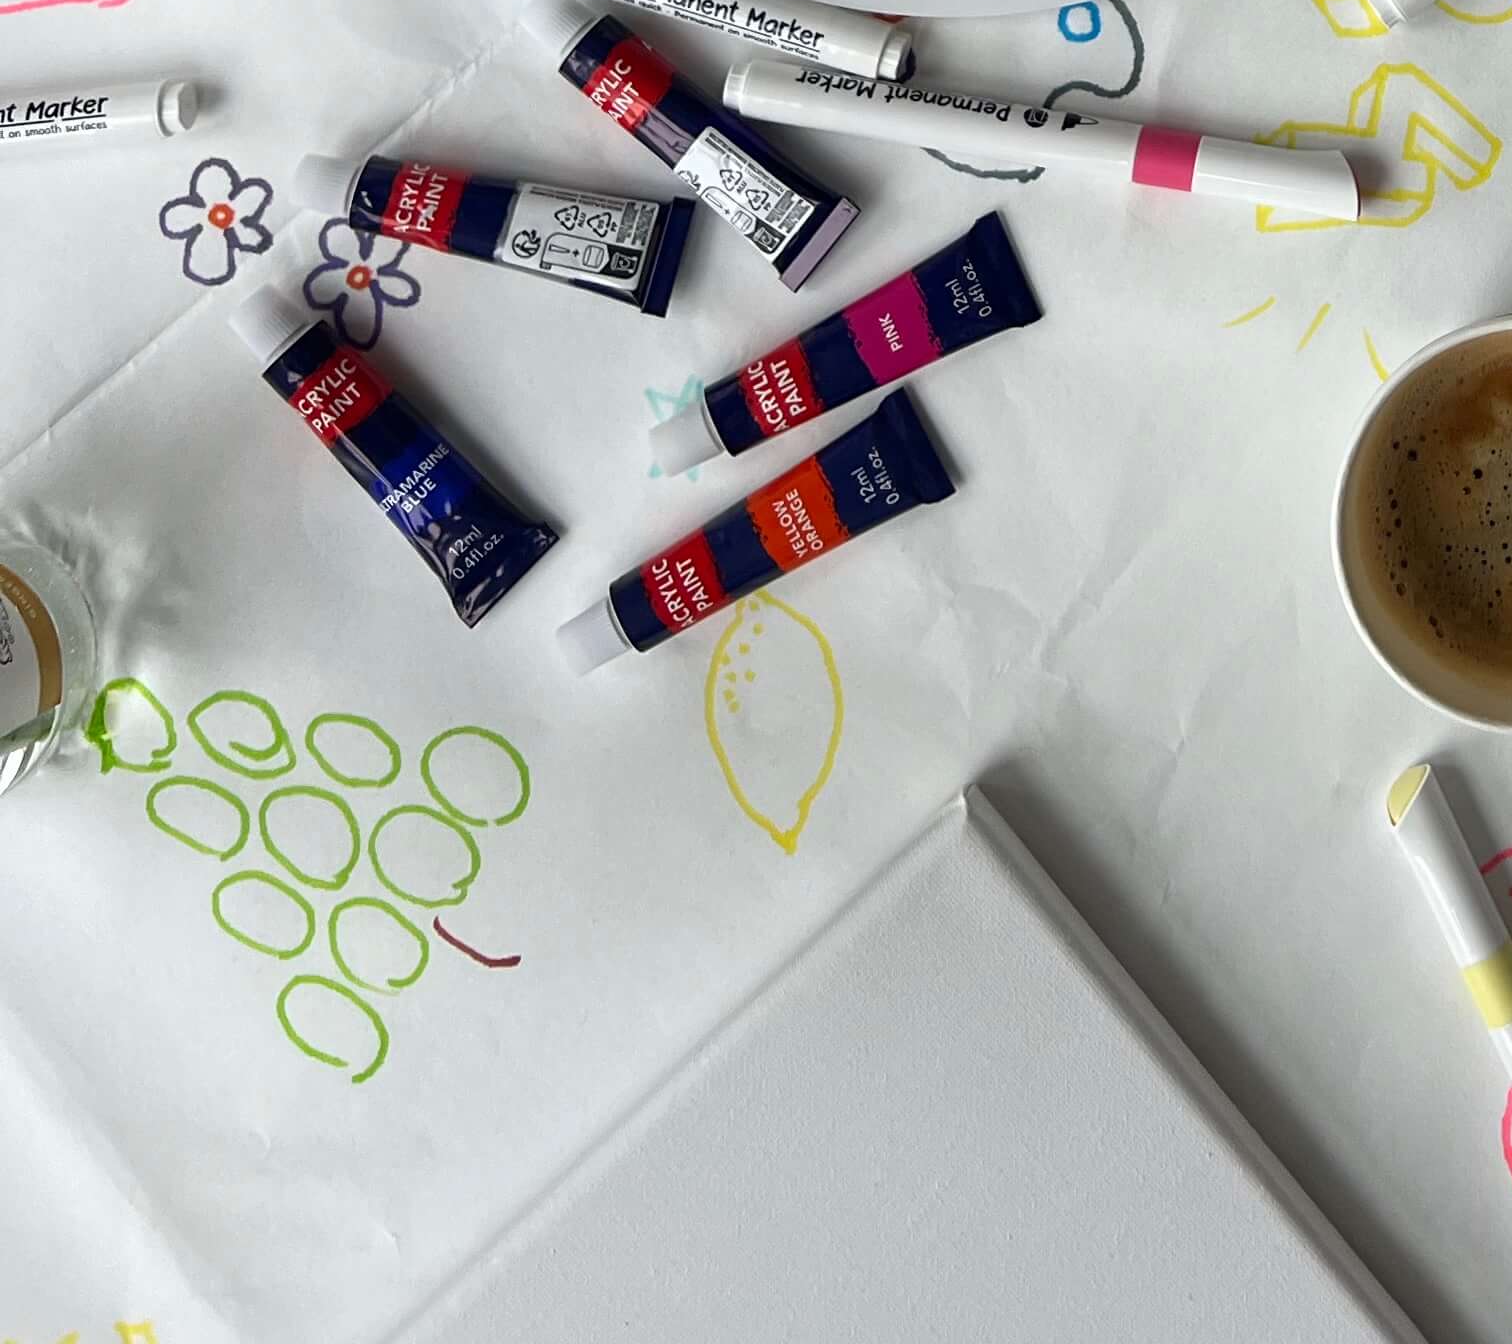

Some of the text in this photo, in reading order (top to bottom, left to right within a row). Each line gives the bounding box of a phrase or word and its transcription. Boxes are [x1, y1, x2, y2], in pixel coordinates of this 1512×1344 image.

[745, 6, 827, 50] Marker
[23, 94, 110, 121] Marker
[590, 57, 632, 107] RYLIC
[606, 80, 642, 122] AINT
[794, 68, 1011, 122] Permanent Marker
[8, 118, 107, 138] on smooth surfaces
[415, 171, 446, 232] PAINT
[943, 277, 972, 315] 12ml
[876, 311, 906, 352] PINK
[294, 356, 357, 417] CRYLIC
[311, 380, 365, 434] PAINT
[745, 359, 790, 433] ACRYLIC
[769, 357, 808, 416] PAINT
[377, 442, 450, 513] TRAMARINE
[399, 476, 437, 513] BLUE
[849, 466, 880, 504] 12ml
[447, 524, 482, 559] 12ml
[769, 497, 812, 558] YELLOW
[782, 487, 828, 551] ORANGE
[648, 557, 695, 630] ACRYLIC
[674, 554, 714, 613] PAINT
